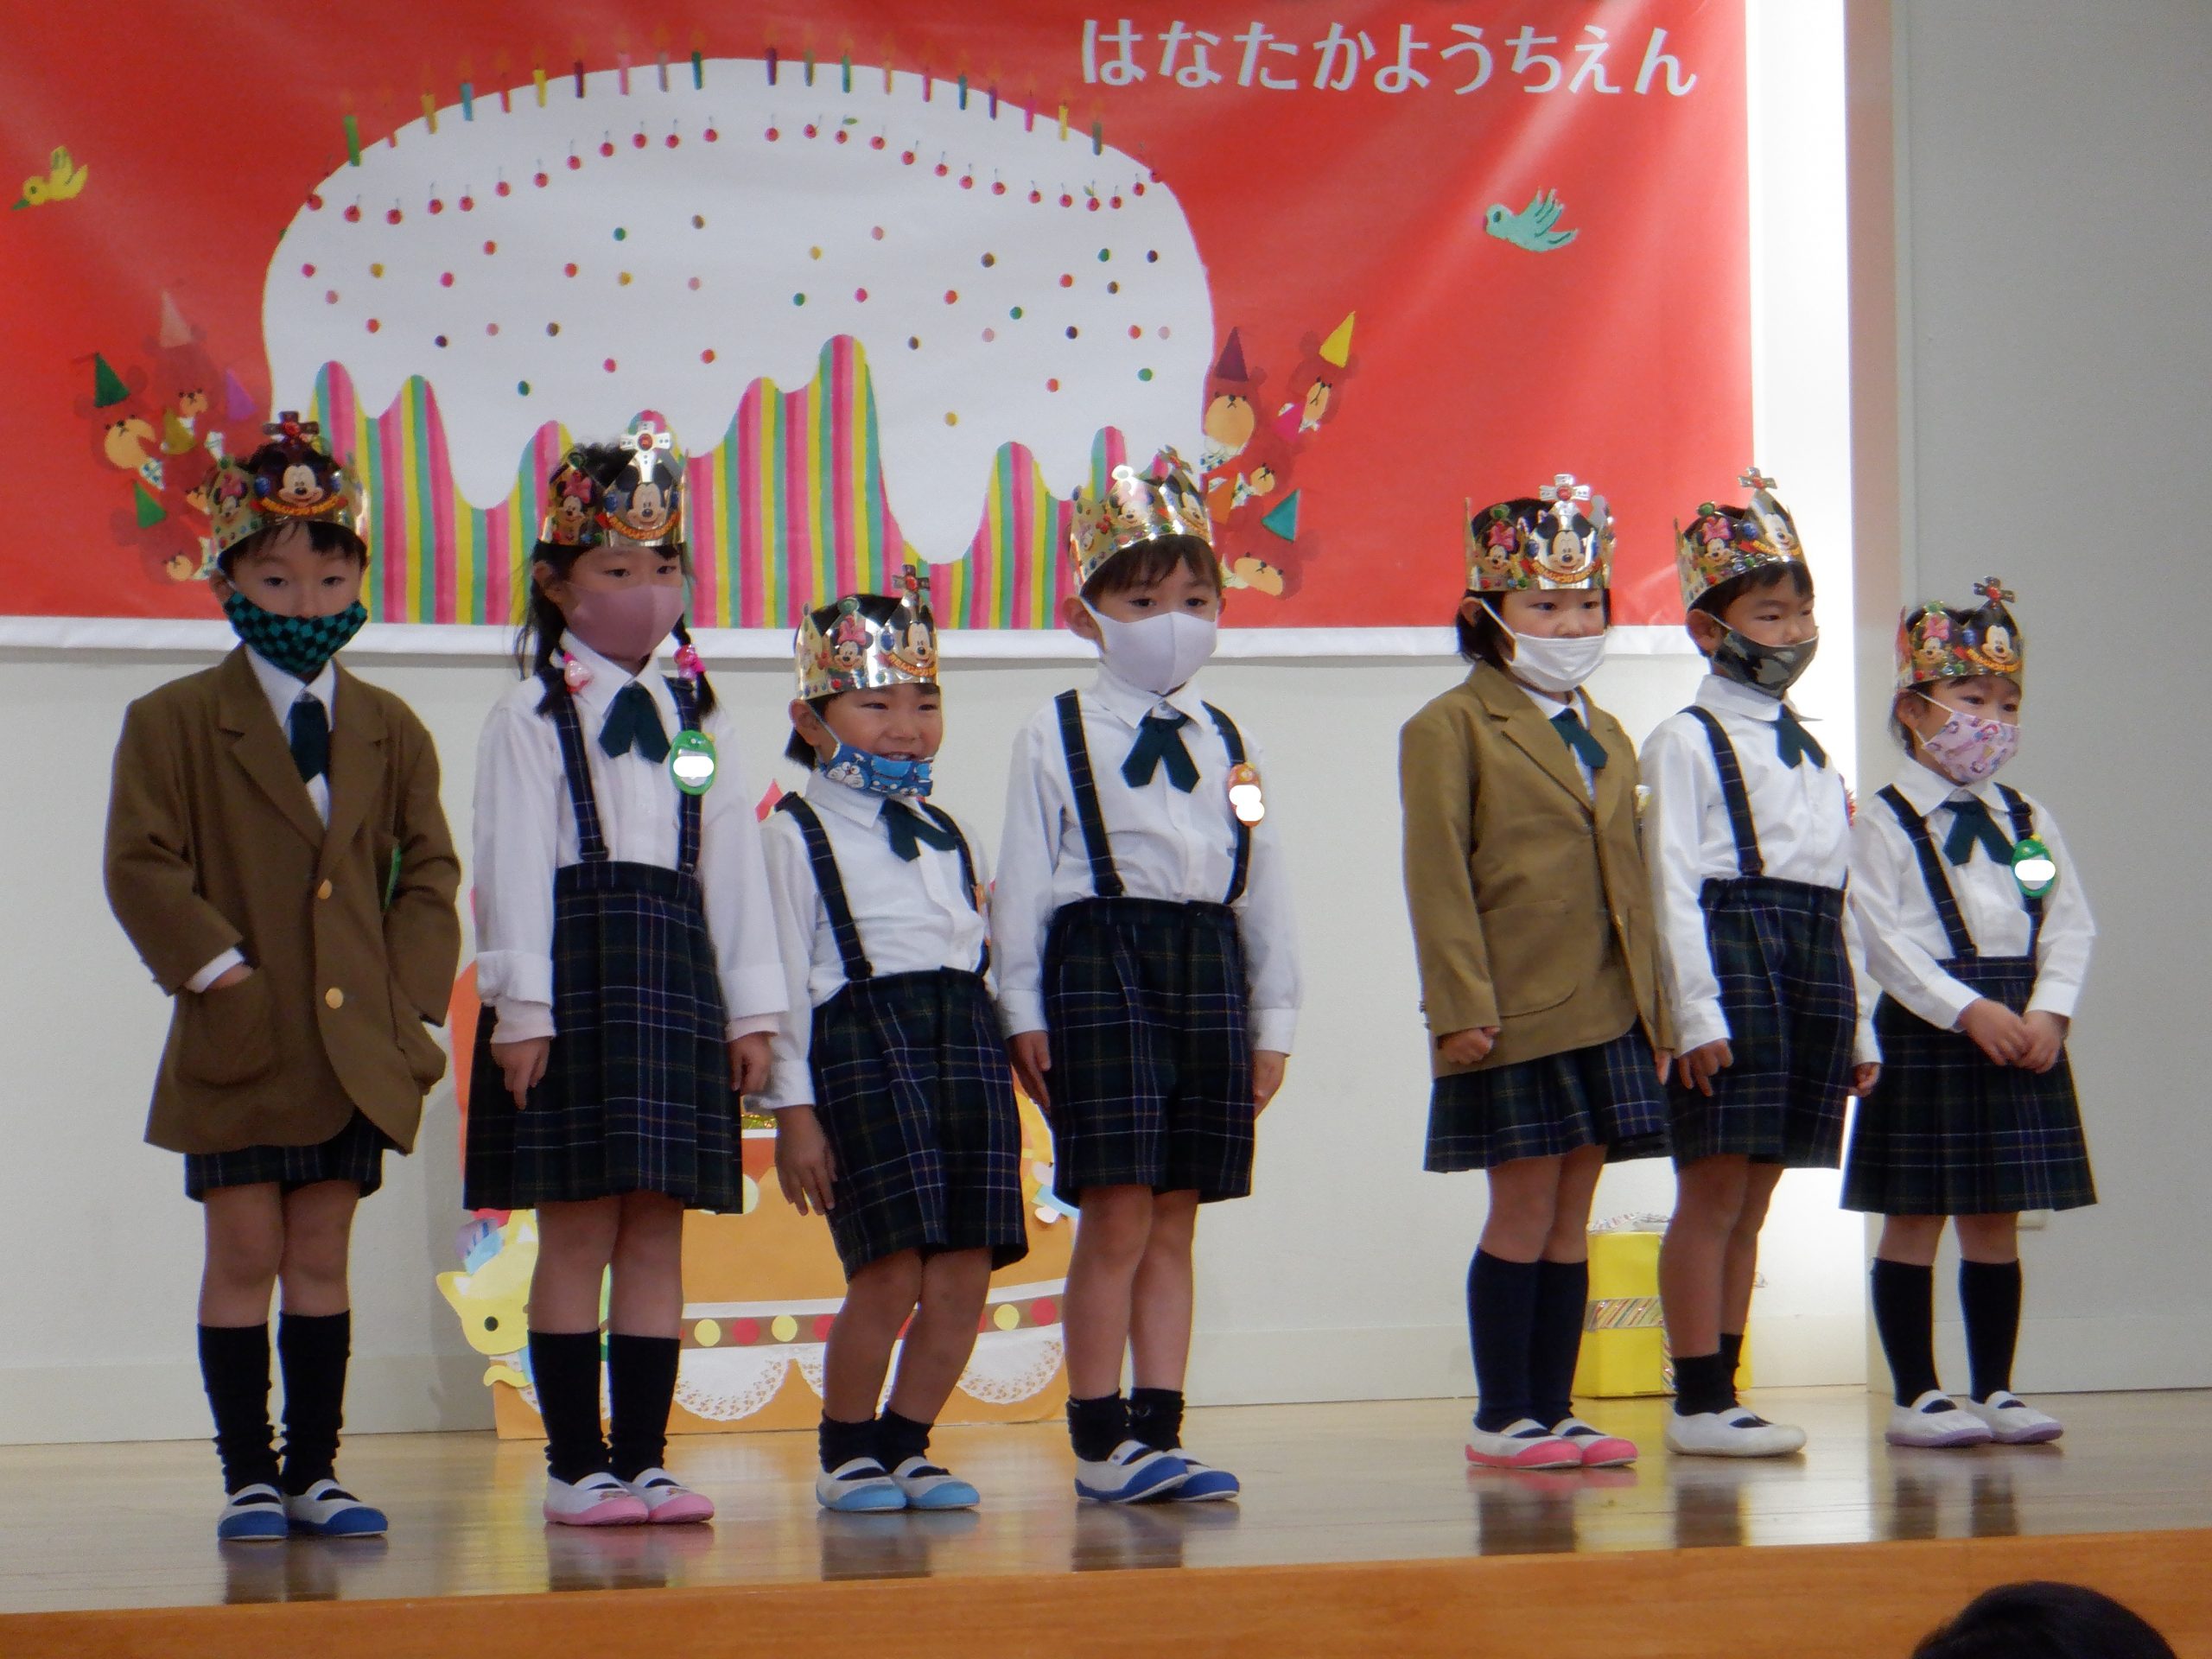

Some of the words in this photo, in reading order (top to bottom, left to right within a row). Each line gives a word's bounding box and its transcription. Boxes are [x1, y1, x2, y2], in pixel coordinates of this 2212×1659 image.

[1082, 18, 1697, 96] はなたかようちえん
